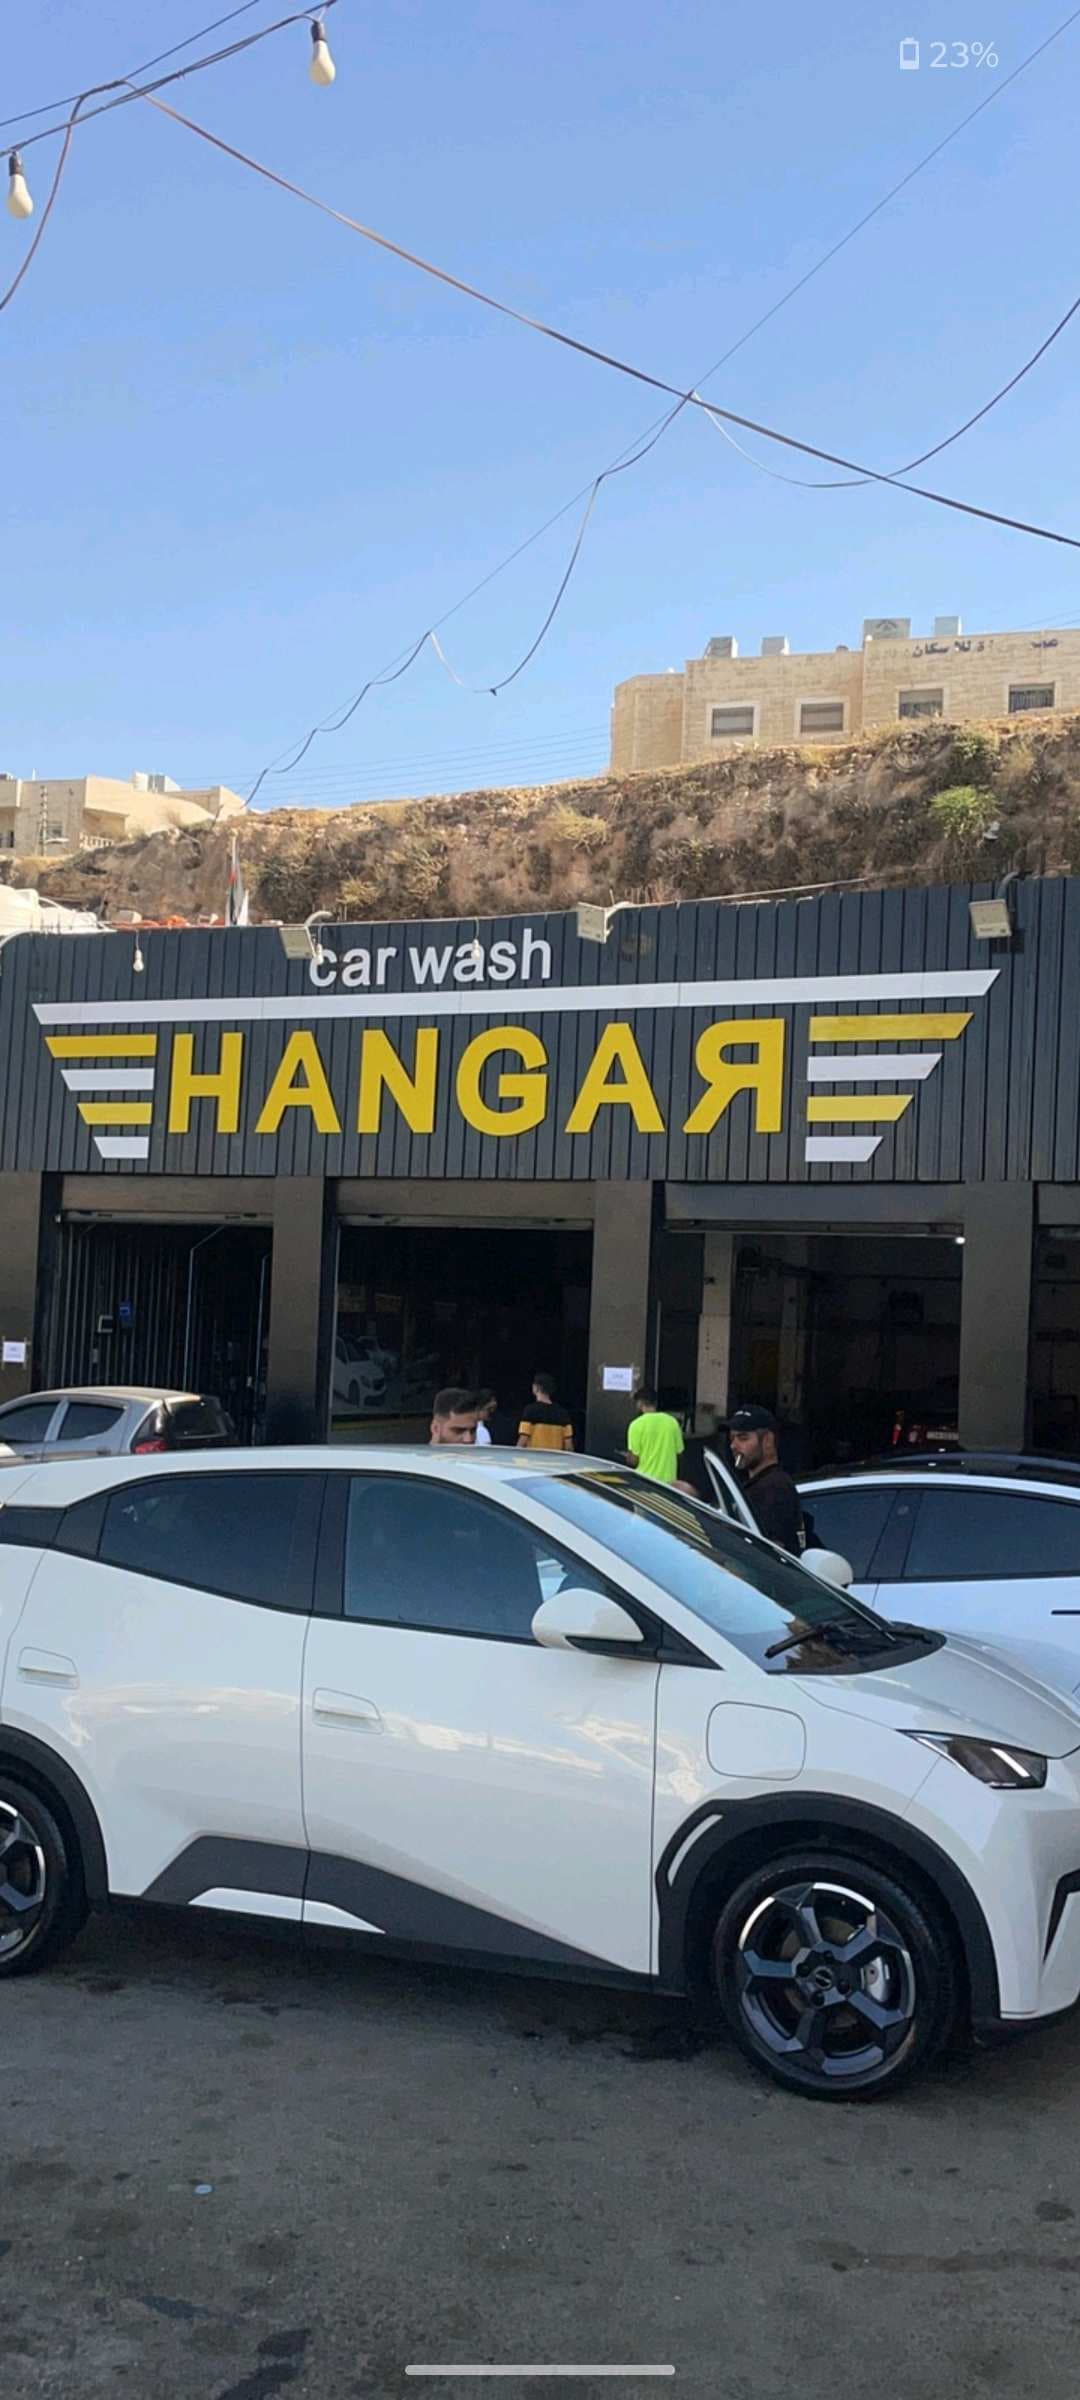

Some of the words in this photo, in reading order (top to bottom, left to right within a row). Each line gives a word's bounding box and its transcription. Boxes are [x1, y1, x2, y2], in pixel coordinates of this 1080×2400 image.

[309, 946, 397, 987] car
[408, 928, 551, 986] wash
[168, 1018, 786, 1136] HANGAR
